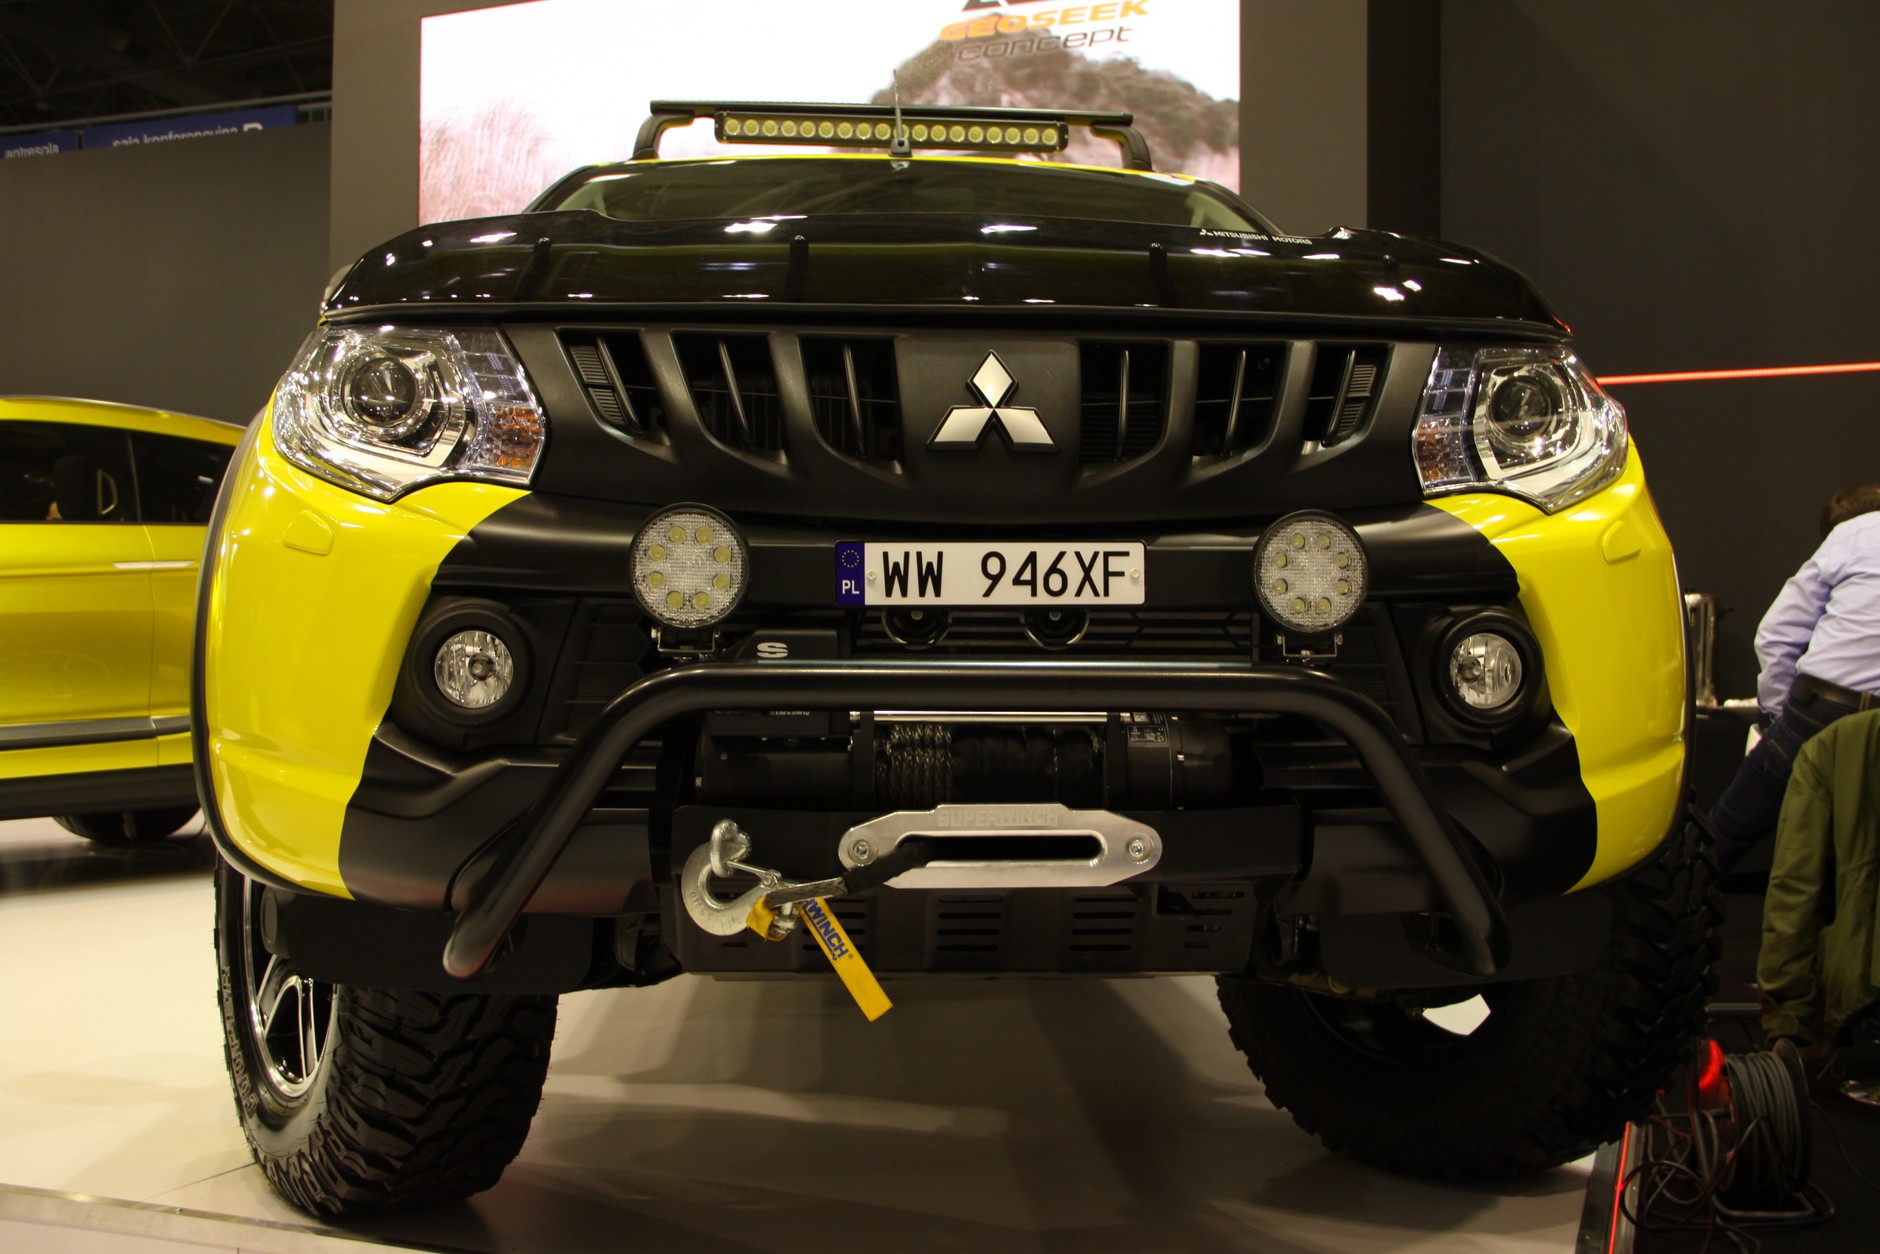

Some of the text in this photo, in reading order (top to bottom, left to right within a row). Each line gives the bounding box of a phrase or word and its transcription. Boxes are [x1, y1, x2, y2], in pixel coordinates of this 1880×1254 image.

[940, 0, 1149, 41] GEOSEEK
[957, 25, 1133, 62] concept
[1212, 230, 1313, 245] MITSUBISHI MOTORS
[841, 579, 861, 595] PL
[882, 550, 1131, 598] WW 946XF
[937, 806, 1059, 828] SUPERWINCH
